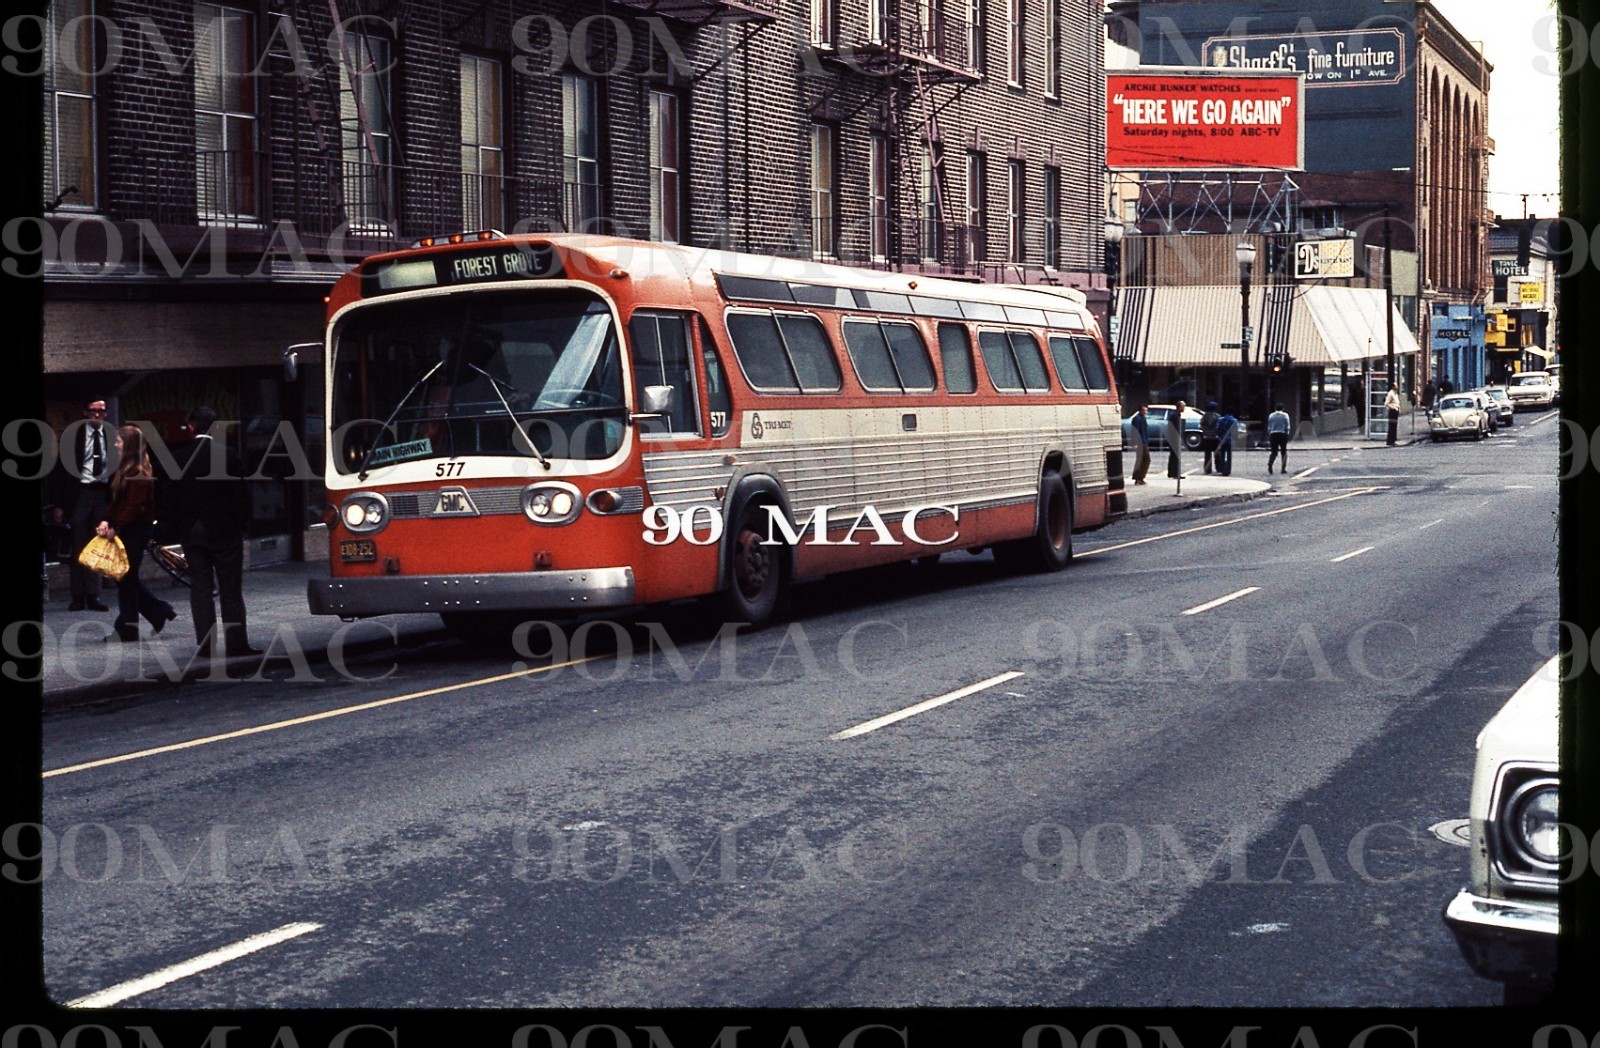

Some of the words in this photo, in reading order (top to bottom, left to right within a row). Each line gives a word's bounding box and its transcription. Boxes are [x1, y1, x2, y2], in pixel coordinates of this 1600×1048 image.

[1308, 48, 1332, 72] fine
[1335, 42, 1395, 67] furniture
[1124, 83, 1157, 92] ARCHIE
[1200, 84, 1241, 93] WATCHES
[1113, 94, 1168, 125] “HERE
[1171, 99, 1200, 125] WE
[1202, 99, 1227, 125] GO
[1230, 96, 1291, 125] AGAIN”
[1124, 127, 1168, 138] Saturday
[1172, 127, 1206, 138] nights,
[1210, 128, 1234, 137] 8:00
[1241, 128, 1281, 137] ABC-TV
[453, 255, 498, 279] FOREST
[502, 252, 543, 273] GROVE
[1299, 244, 1319, 273] D's
[1496, 267, 1527, 275] HOTEL
[710, 411, 726, 427] 577
[391, 441, 428, 458] HIGHWAY
[435, 461, 465, 477] 577
[441, 493, 465, 512] GMC
